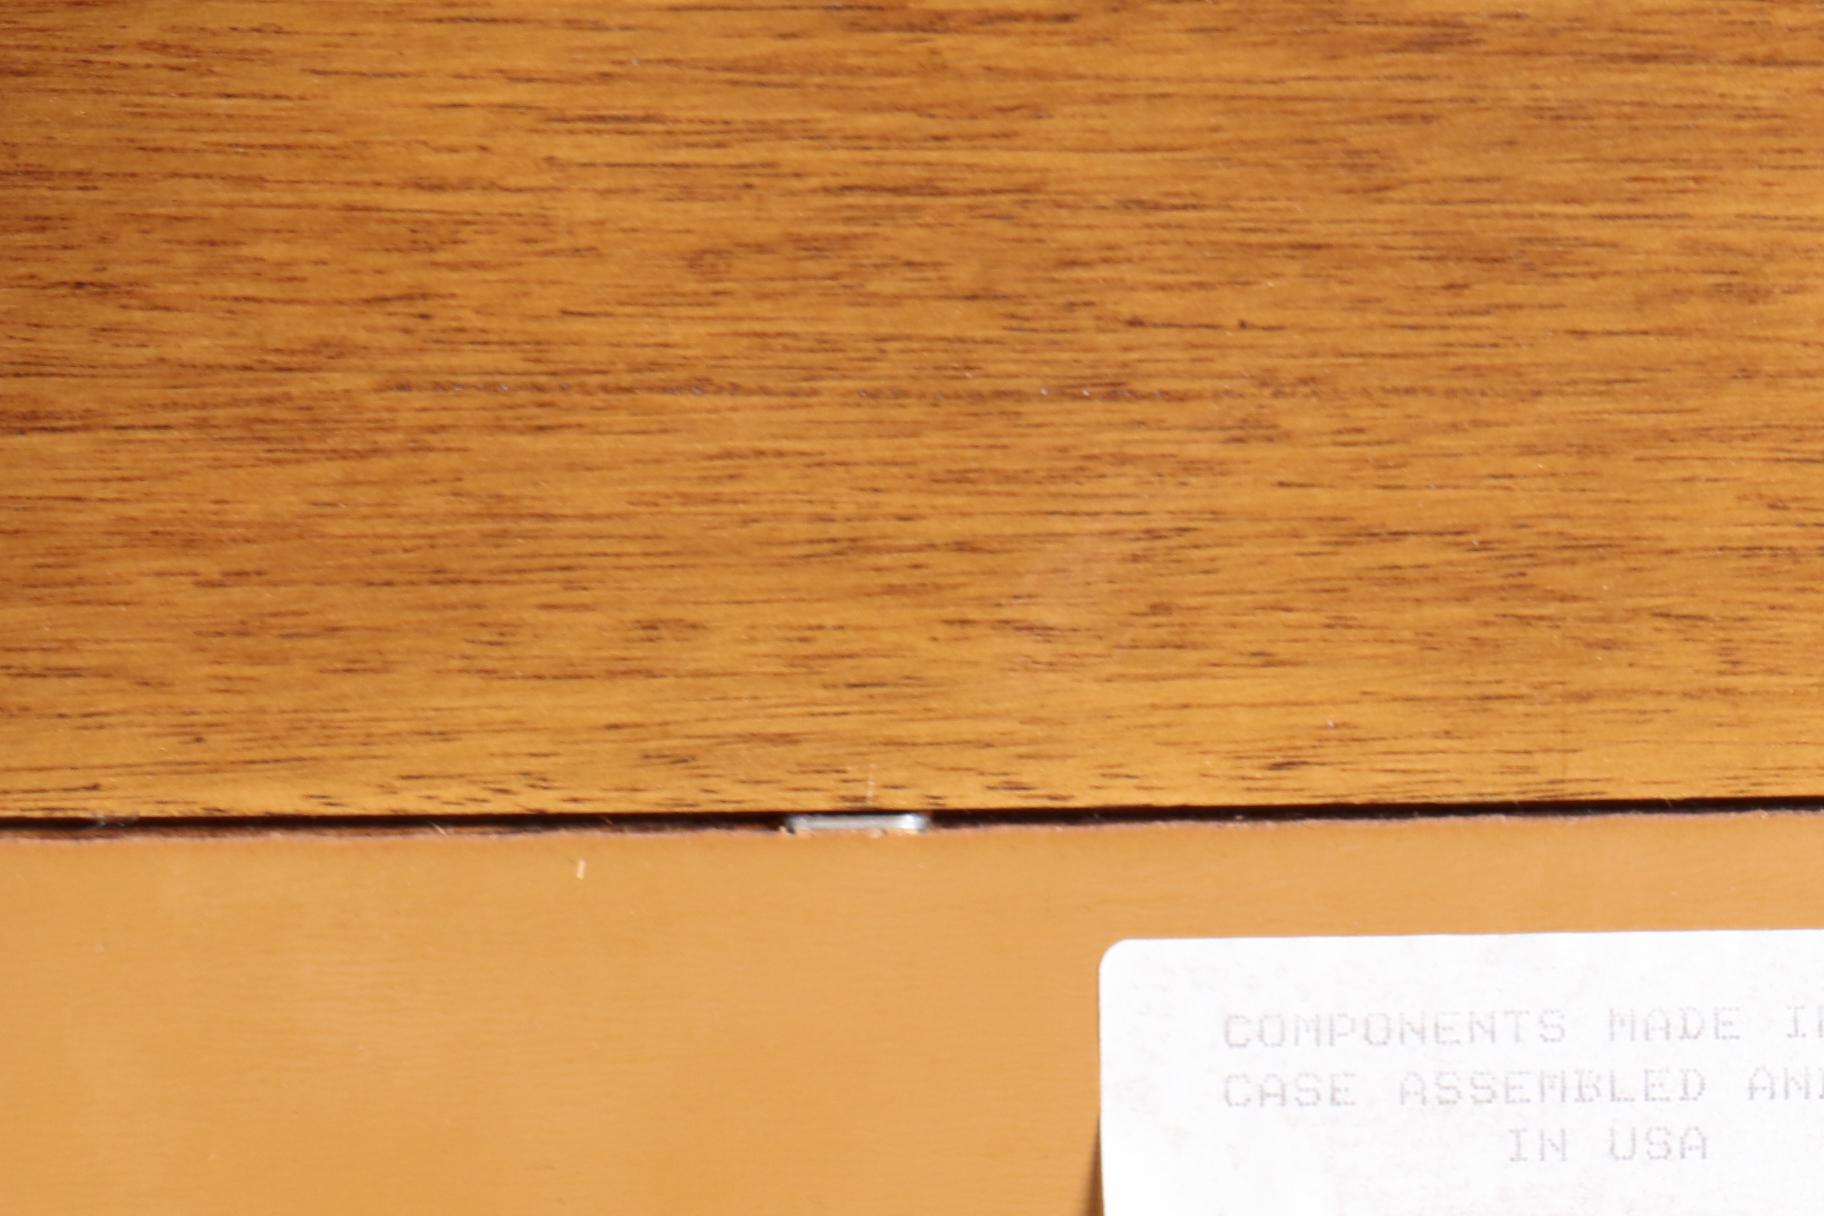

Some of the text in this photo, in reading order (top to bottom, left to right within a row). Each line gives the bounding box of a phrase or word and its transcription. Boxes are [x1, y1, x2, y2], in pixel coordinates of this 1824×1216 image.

[1222, 1008, 1567, 1048] COMPONENTS
[1608, 1006, 1742, 1043] MADE
[1222, 1071, 1358, 1107] CASE
[1399, 1068, 1706, 1106] ASSEMBLED
[1507, 1125, 1708, 1163] IN USA
